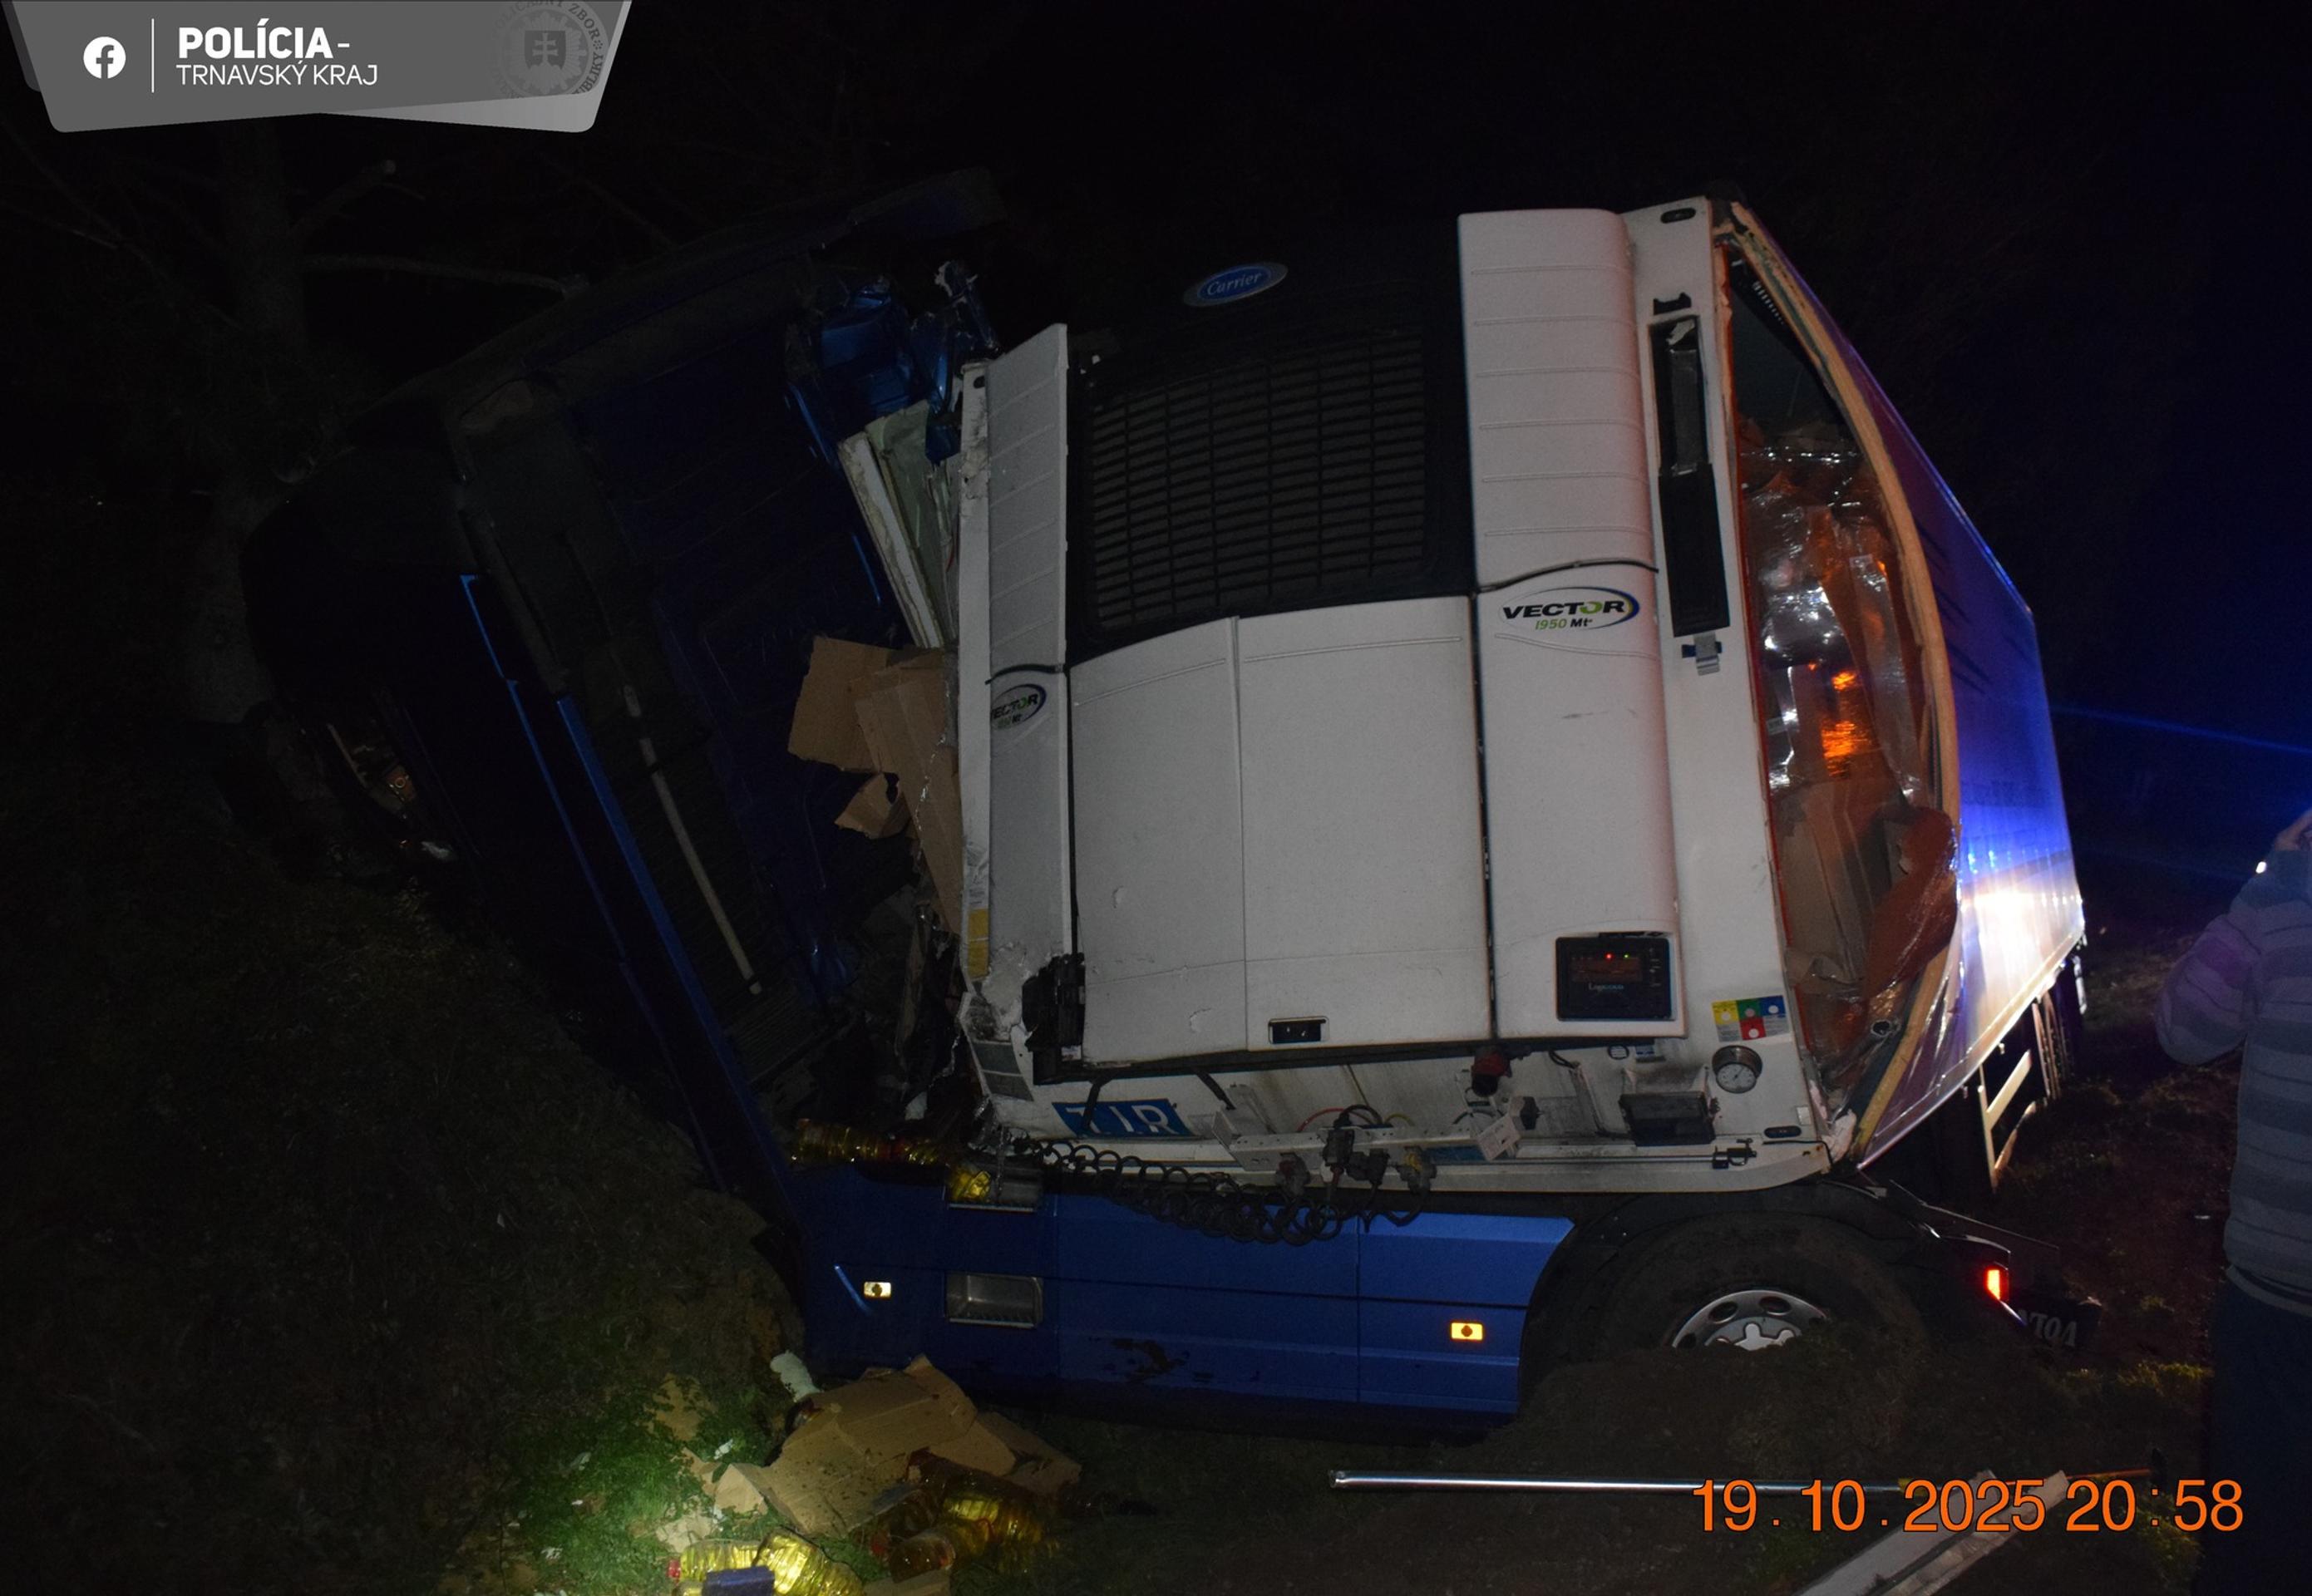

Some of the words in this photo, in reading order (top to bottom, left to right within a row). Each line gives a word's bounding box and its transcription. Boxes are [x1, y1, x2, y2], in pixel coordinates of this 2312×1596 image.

[1206, 272, 1263, 296] Carrier
[1502, 600, 1625, 619] VECTOR
[1535, 618, 1567, 630] 1950
[990, 693, 1038, 719] ECTOR
